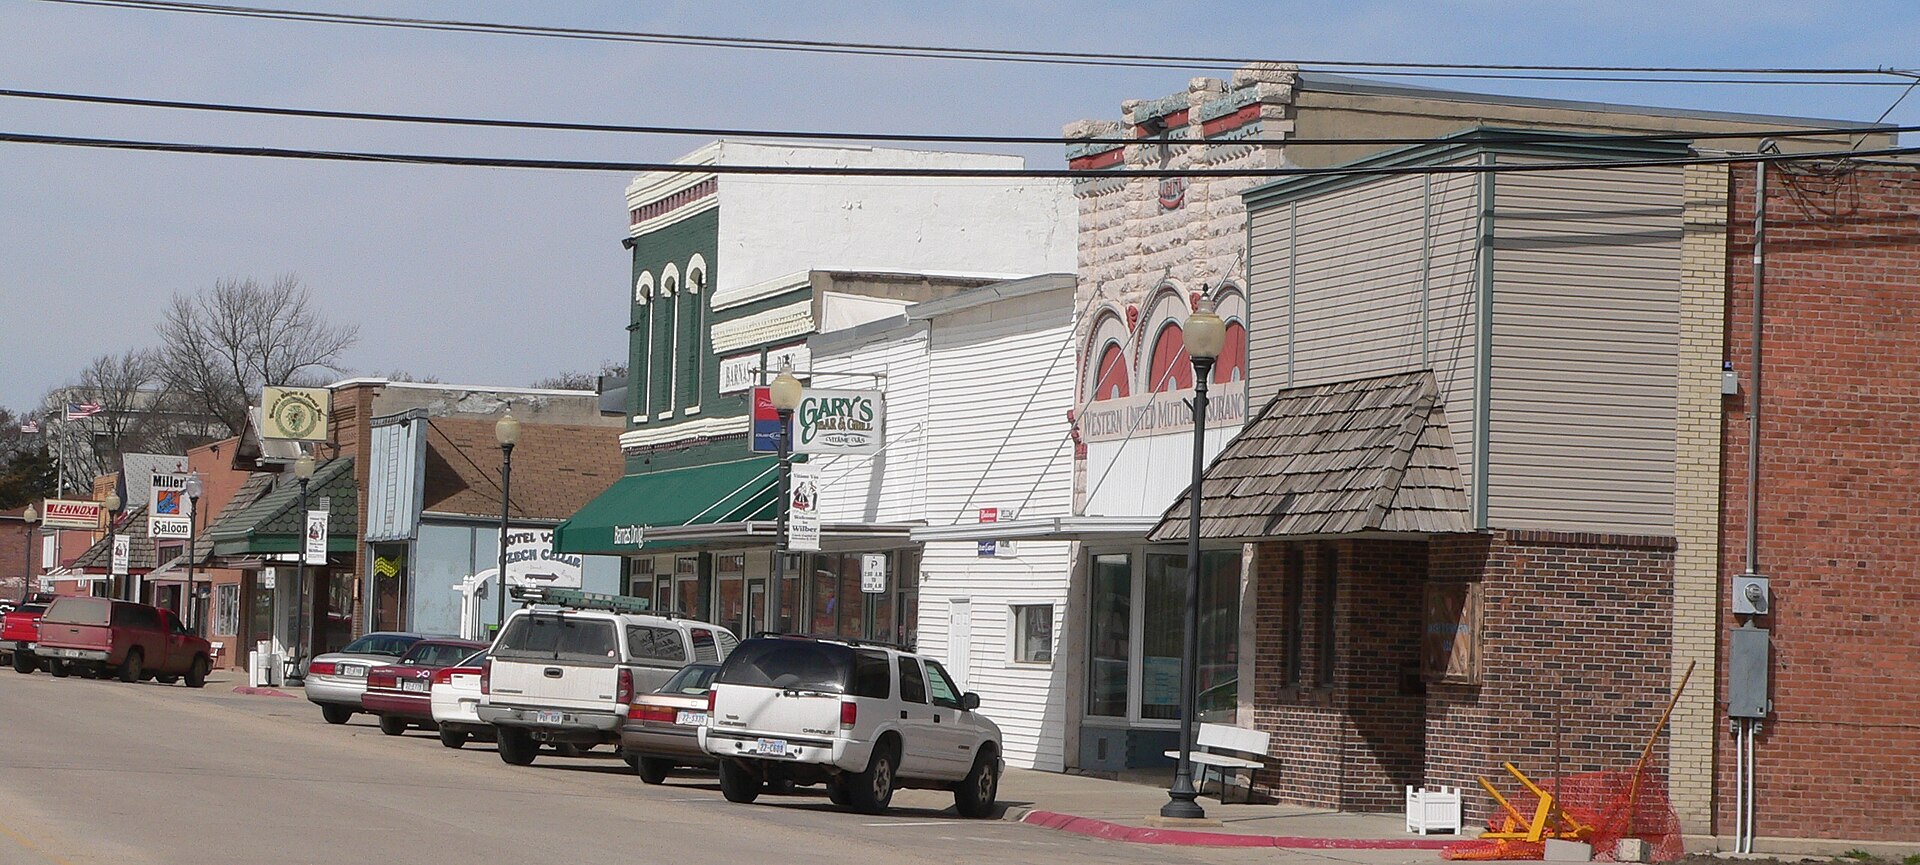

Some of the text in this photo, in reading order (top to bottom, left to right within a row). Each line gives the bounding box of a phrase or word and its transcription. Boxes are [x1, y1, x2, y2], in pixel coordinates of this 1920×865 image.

[800, 396, 874, 445] GARY'S
[816, 416, 874, 432] BAR & GRILL
[1084, 409, 1122, 437] WESTERN
[1126, 401, 1156, 432] UNITED
[153, 475, 187, 488] Miller'
[54, 504, 94, 515] LENNOX
[153, 520, 188, 535] Saloon
[792, 524, 818, 533] Wilber
[507, 532, 536, 546] OTEL
[614, 525, 631, 545] Barnas
[631, 524, 644, 549] Drug
[506, 548, 581, 568] ZECH CELLAR
